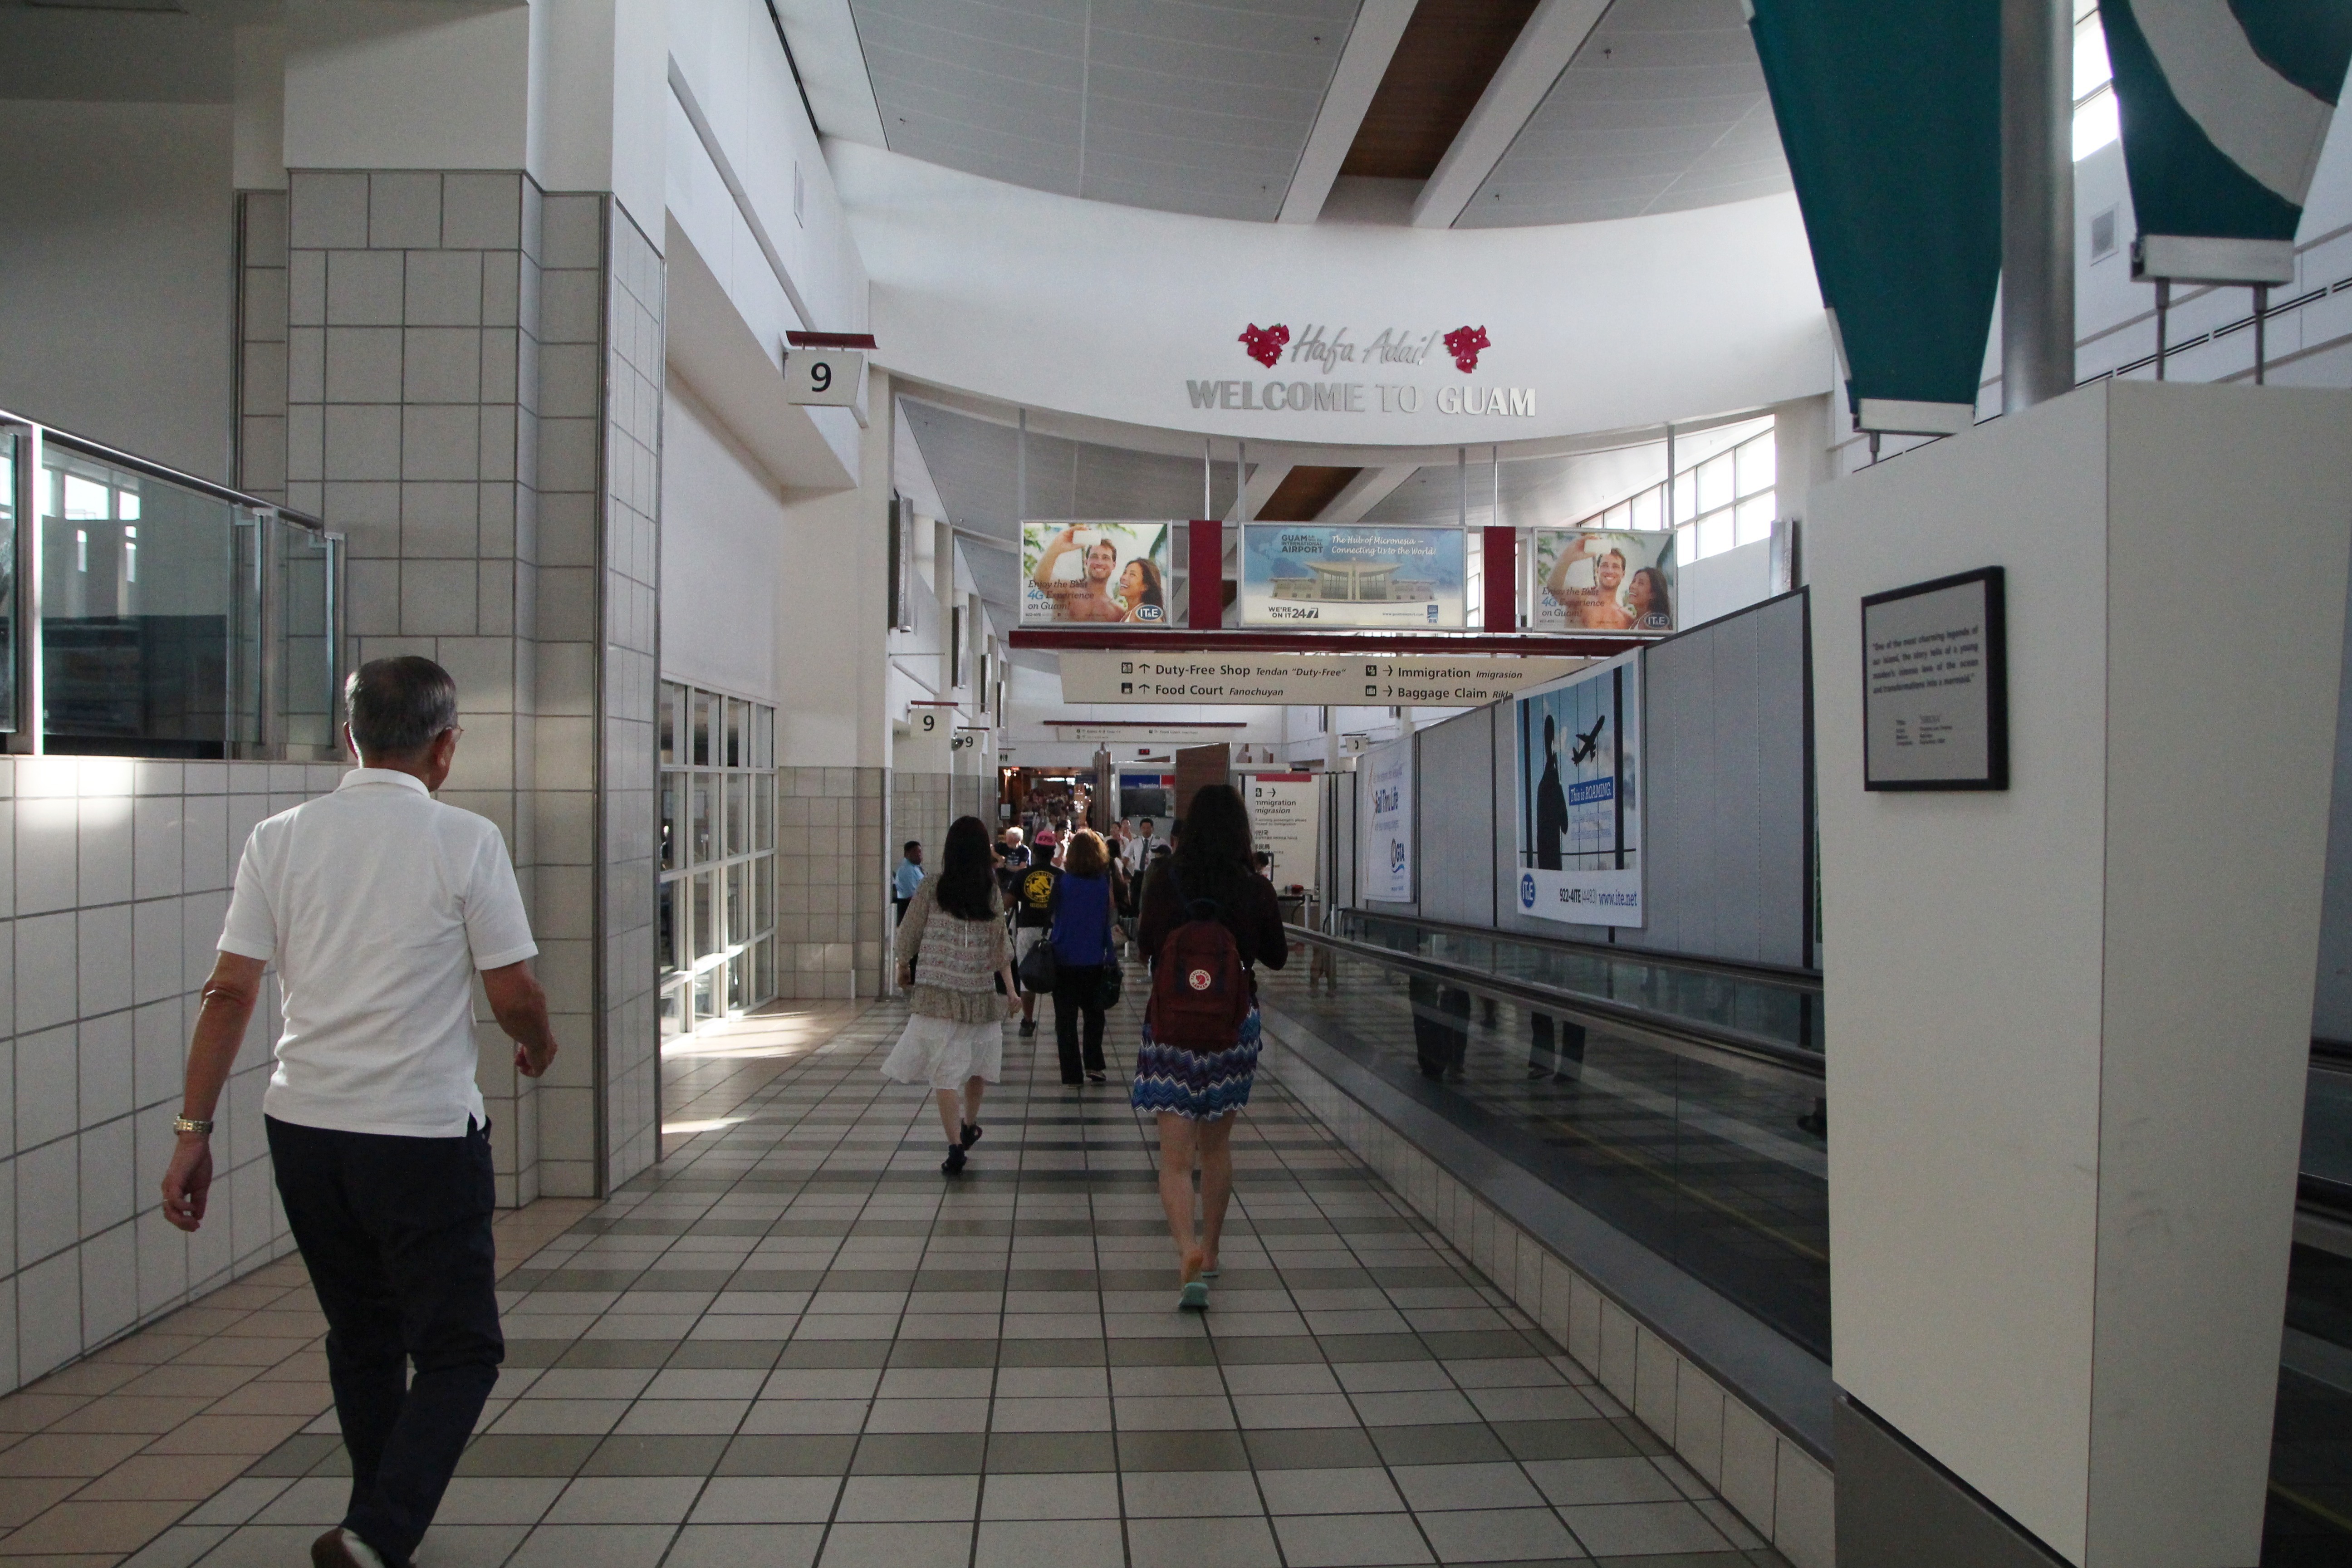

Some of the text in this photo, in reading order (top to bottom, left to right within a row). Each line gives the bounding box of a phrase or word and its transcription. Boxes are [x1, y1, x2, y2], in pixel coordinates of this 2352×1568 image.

[1362, 327, 1441, 366] Adai!
[811, 362, 832, 392] 9
[1186, 379, 1536, 417] WELCOME TO GUAM
[1332, 535, 1346, 544] The
[1365, 536, 1373, 545] of
[1374, 536, 1416, 544] Micronesia
[1332, 546, 1376, 556] Connecting
[1411, 547, 1436, 555] World!
[1028, 580, 1052, 589] Enjoy
[1070, 580, 1088, 588] Best
[1027, 589, 1094, 601] 4G Experience
[1567, 587, 1579, 595] the
[1542, 596, 1558, 607] 4G
[1156, 665, 1215, 677] Duty-Free
[1220, 665, 1250, 677] Shop
[1257, 667, 1288, 676] Tendan
[1398, 667, 1523, 680] Immigration Imigrasion
[1156, 685, 1284, 697] Food Court Fanochuyan
[1398, 688, 1450, 700] Baggage
[1455, 688, 1487, 698] Claim
[923, 715, 935, 731] 9
[965, 736, 974, 747] 9
[1571, 787, 1580, 802] This
[1581, 789, 1585, 800] is
[1255, 799, 1296, 807] mmigration
[1559, 888, 1581, 903] 922-4ITE
[1599, 890, 1637, 906] www.ite.net
